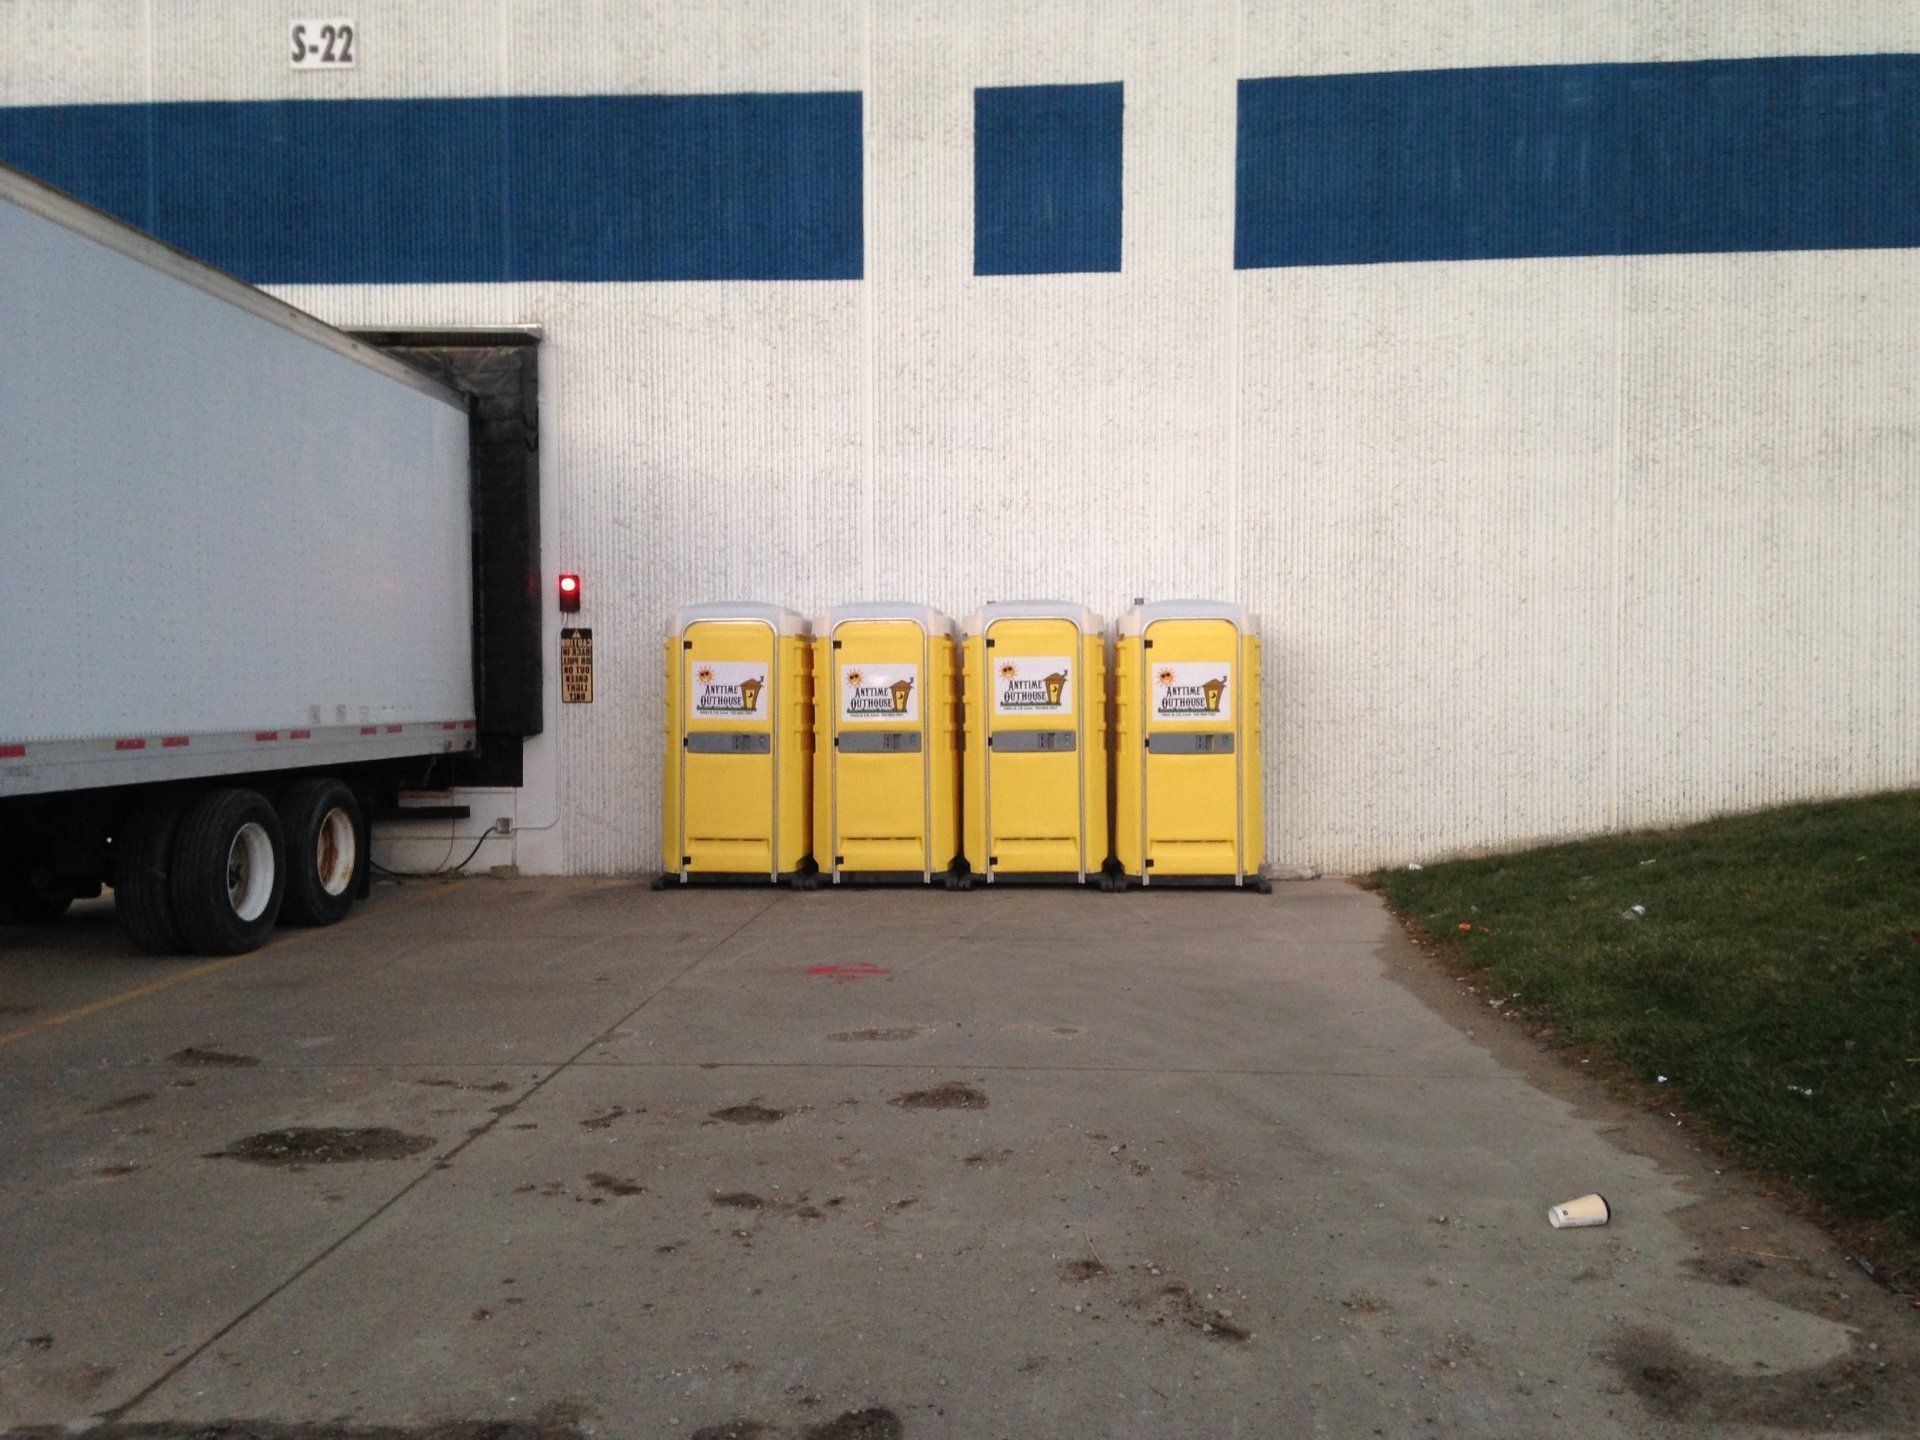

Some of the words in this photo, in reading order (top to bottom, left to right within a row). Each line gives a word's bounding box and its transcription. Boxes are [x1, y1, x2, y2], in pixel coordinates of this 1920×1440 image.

[292, 24, 353, 62] S-22
[705, 684, 739, 695] ANYTIME
[1008, 680, 1043, 691] ANYTIME
[854, 687, 889, 698] ANYTIME
[1004, 691, 1047, 702] OUTHOUSE
[1166, 686, 1201, 697] ANYTIME
[700, 695, 743, 706] OUTHOUSE
[850, 698, 893, 709] OUTHOUSE
[1161, 697, 1205, 709] OUTHOUSE
